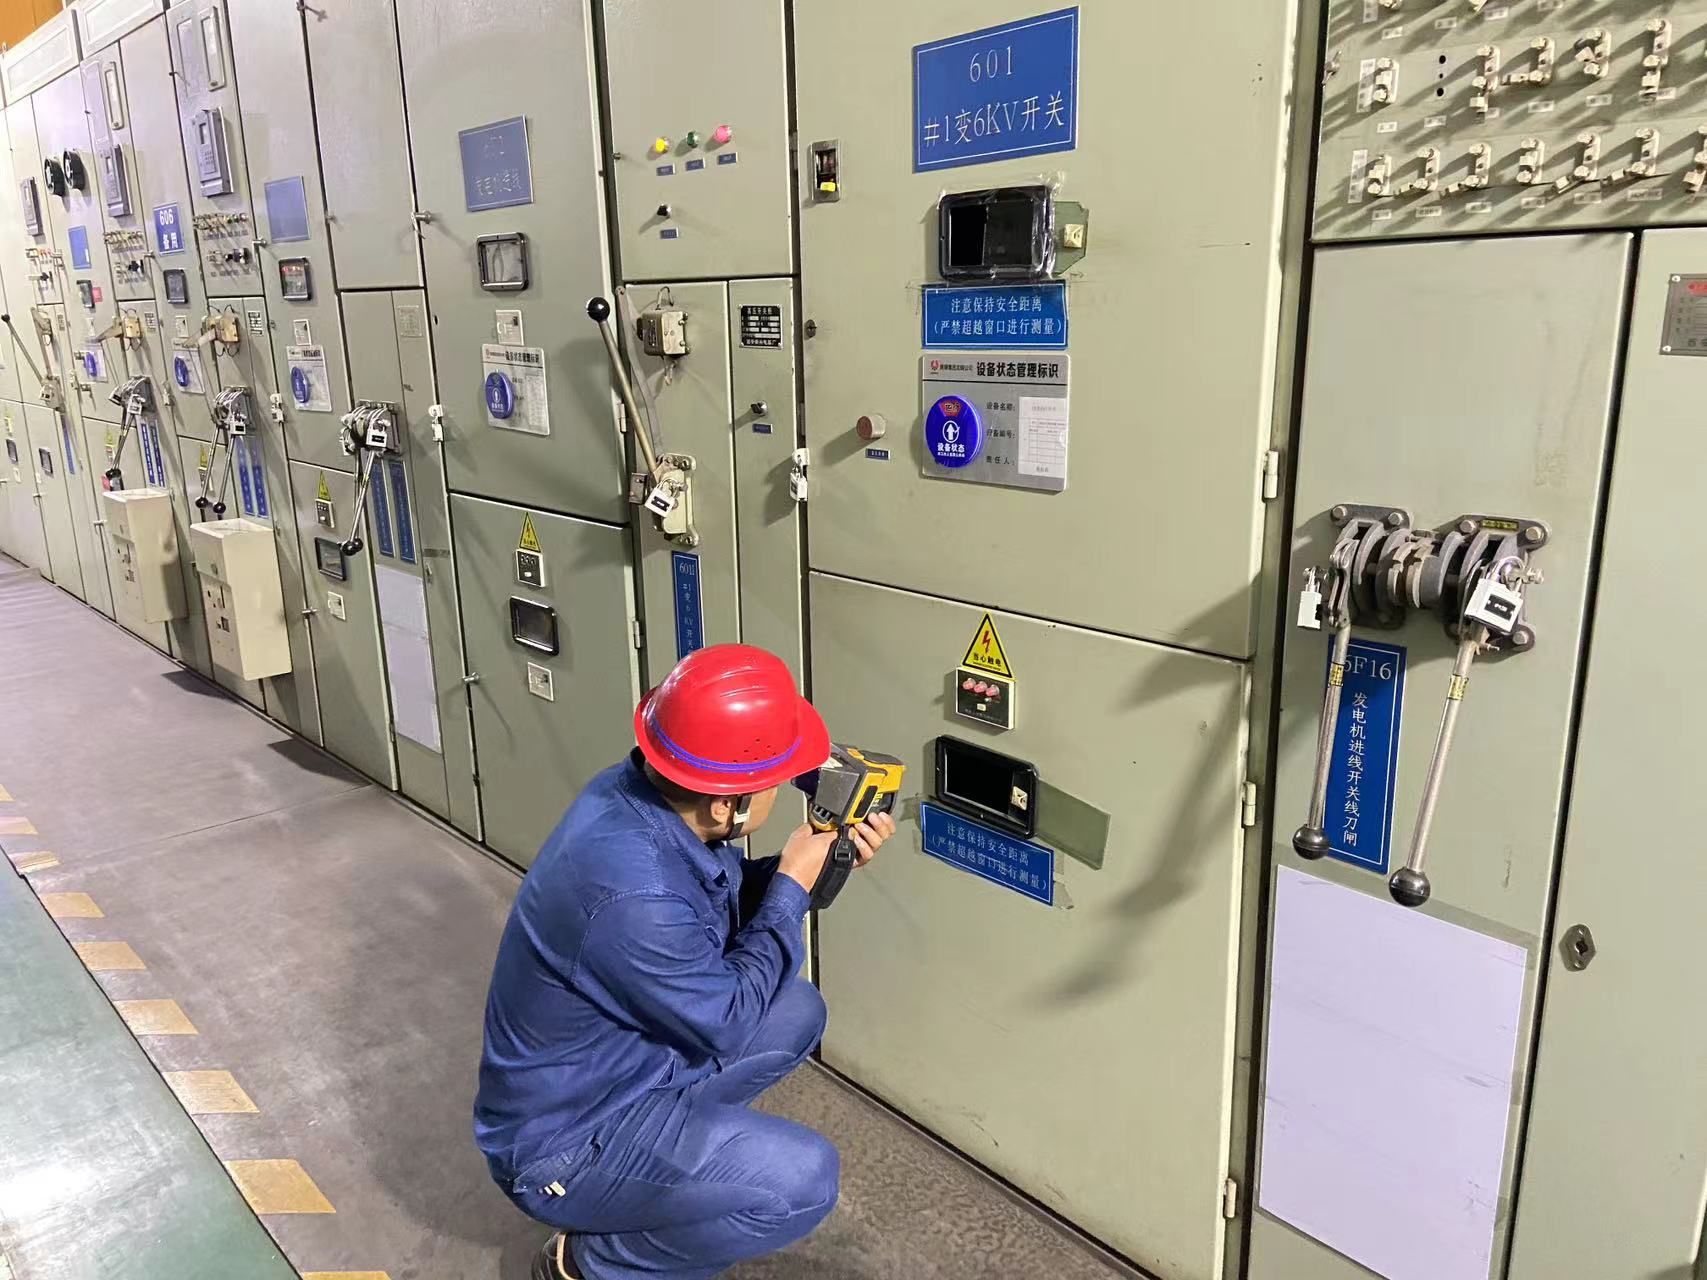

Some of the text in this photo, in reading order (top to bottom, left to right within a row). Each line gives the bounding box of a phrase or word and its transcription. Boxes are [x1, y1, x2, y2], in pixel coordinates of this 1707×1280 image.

[969, 45, 1014, 84] 601
[923, 90, 1065, 148] #1变6KV开关
[160, 209, 174, 225] 606
[950, 294, 1042, 314] 注意保持安全距离
[976, 361, 1060, 379] 设备状态管理标识
[937, 442, 965, 453] 设备状态
[973, 652, 1002, 668] 当心触电
[1343, 692, 1369, 848] 发电机进线开关线刀闸
[946, 821, 1030, 867] 注意保持安全距离
